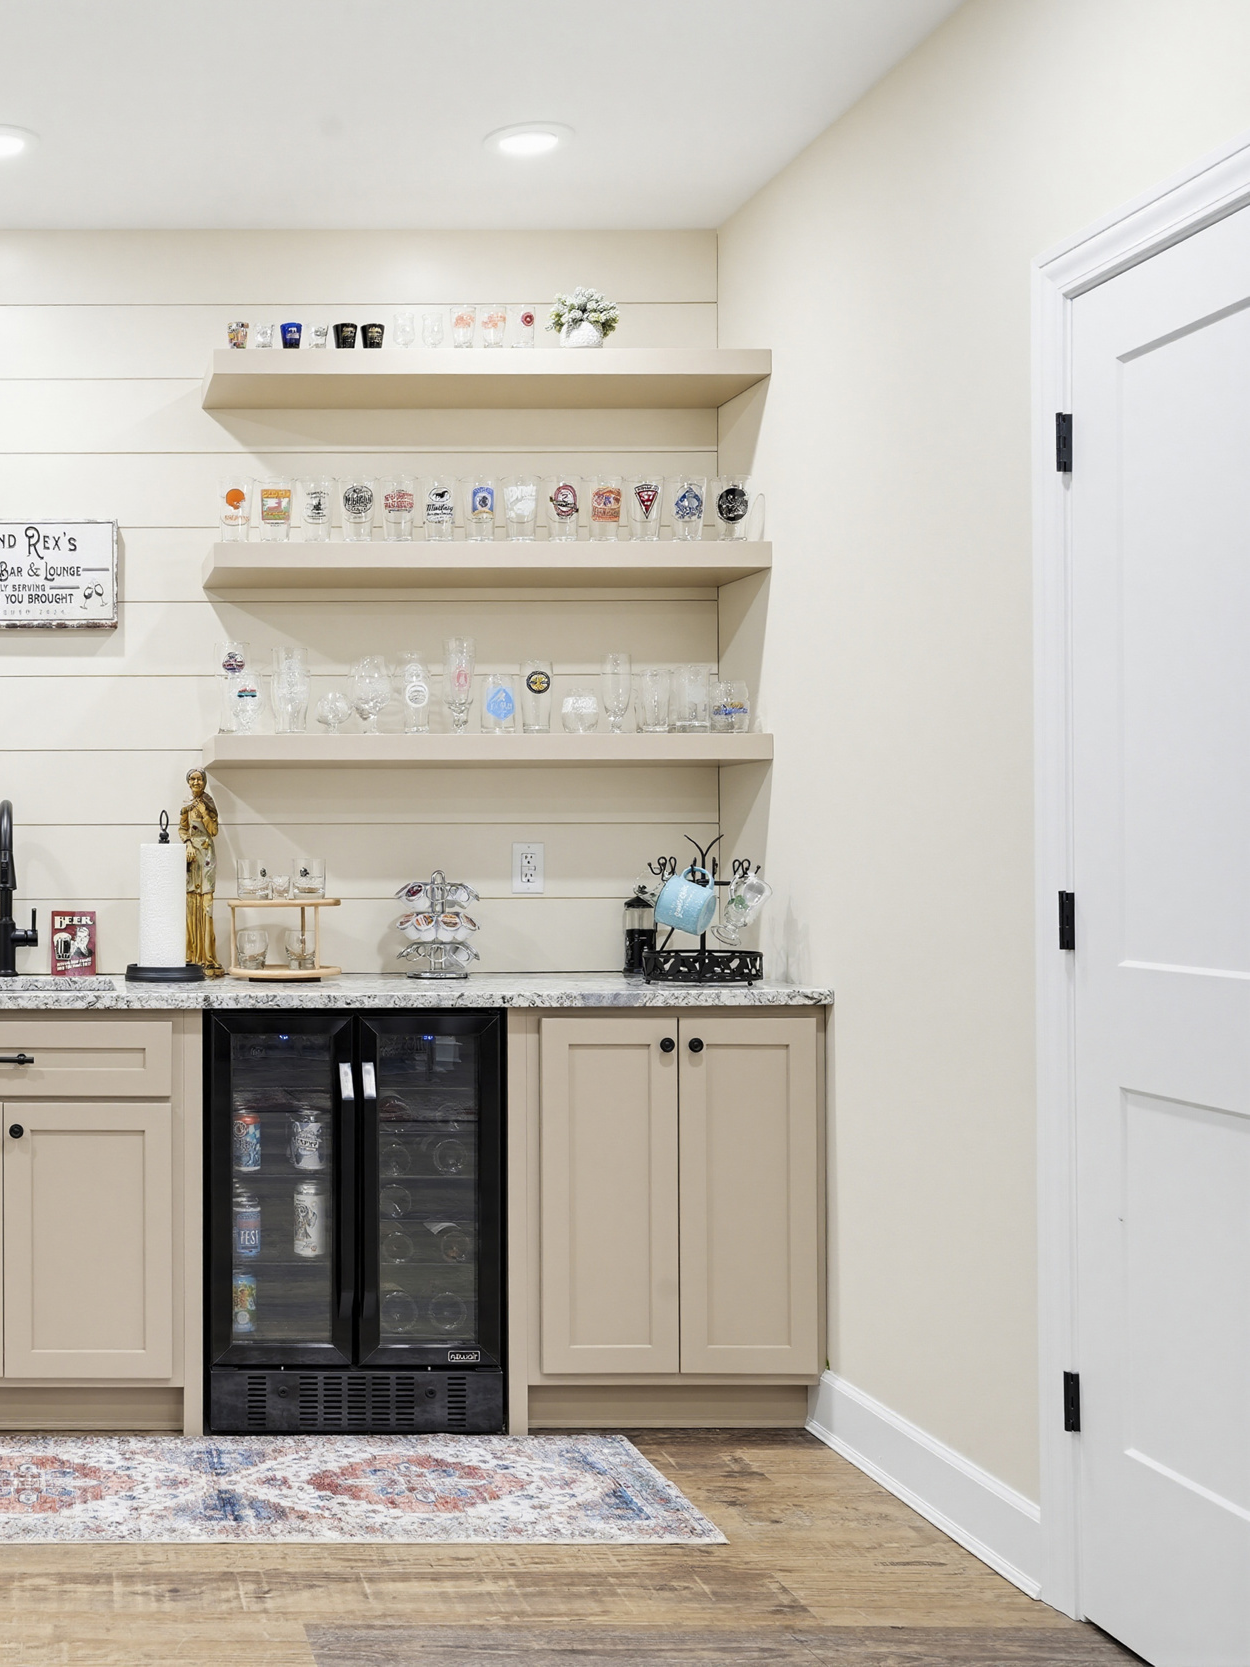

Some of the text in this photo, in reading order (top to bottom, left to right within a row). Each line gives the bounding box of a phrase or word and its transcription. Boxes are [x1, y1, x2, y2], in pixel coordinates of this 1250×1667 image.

[27, 562, 41, 577] &
[12, 584, 46, 592] SERVING
[5, 593, 24, 604] YOU
[27, 593, 74, 604] BROUGHT
[54, 916, 94, 929] BEER
